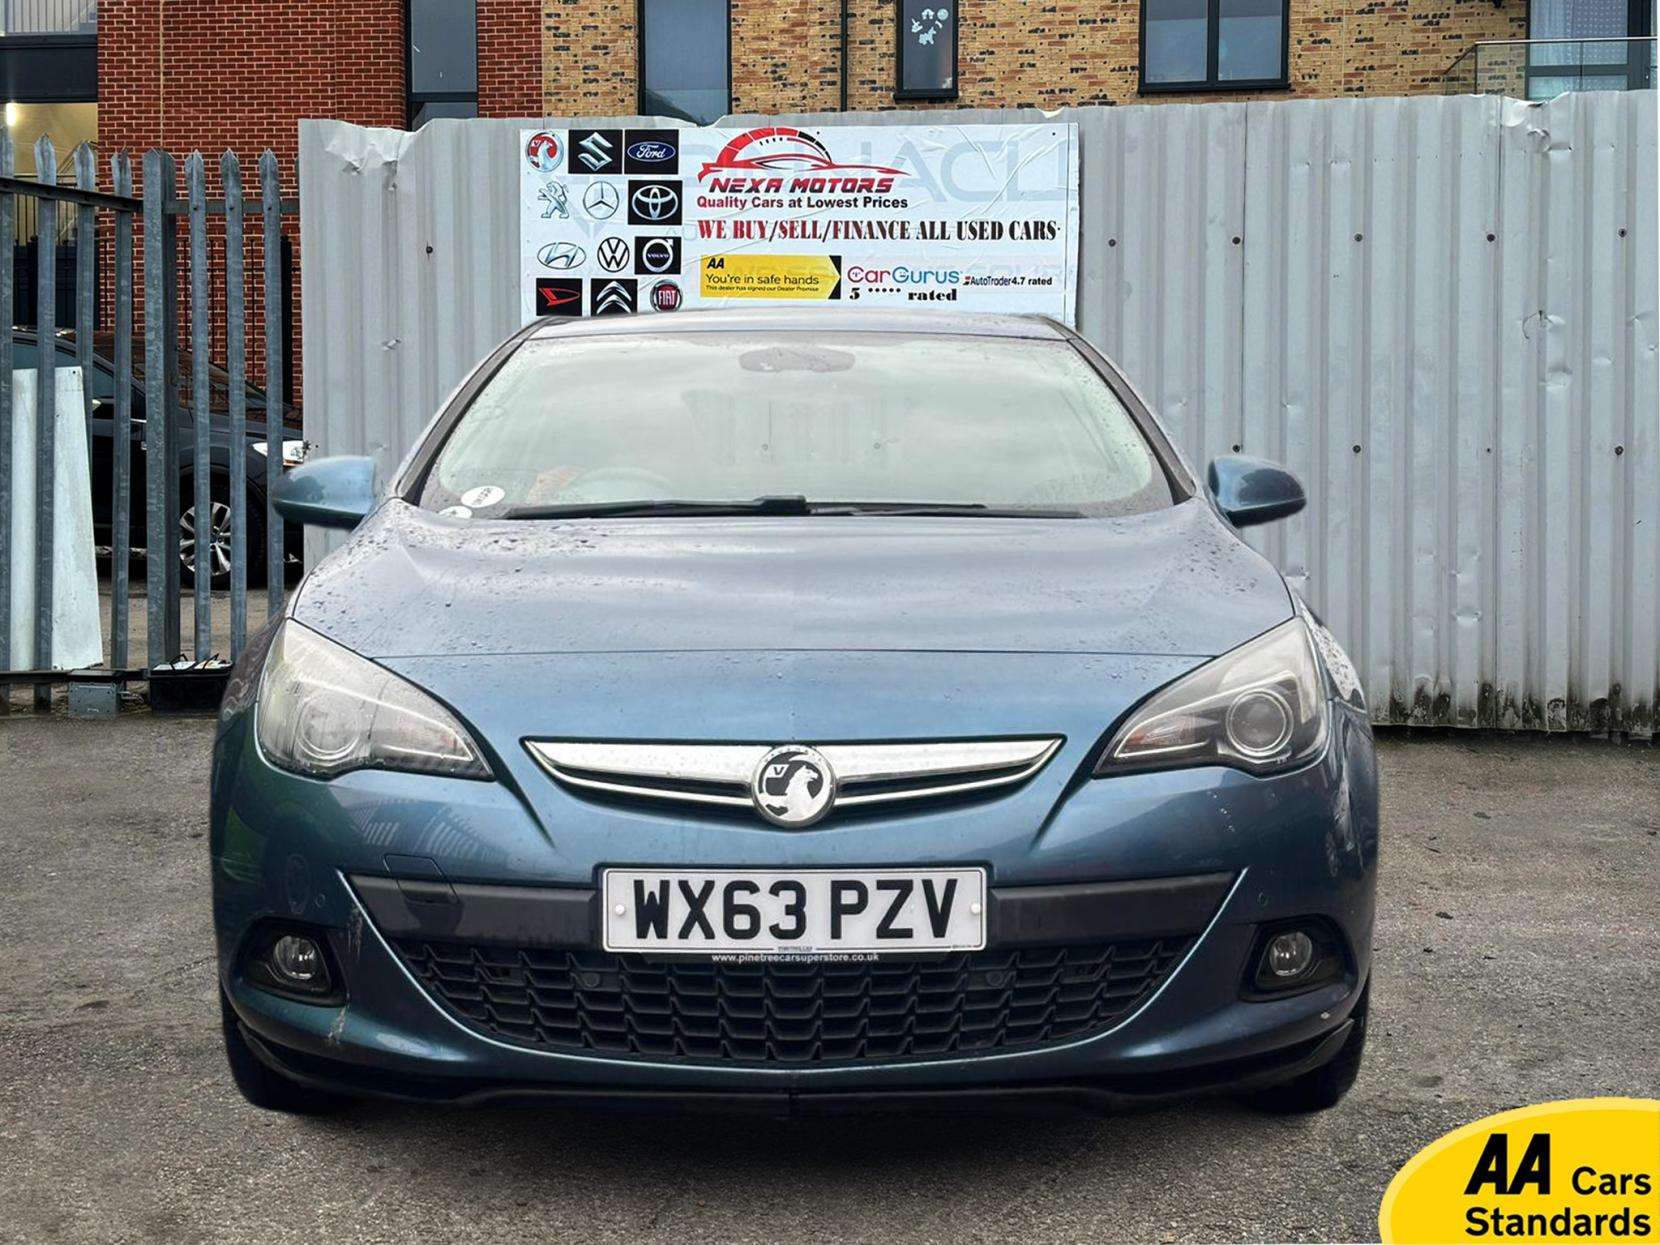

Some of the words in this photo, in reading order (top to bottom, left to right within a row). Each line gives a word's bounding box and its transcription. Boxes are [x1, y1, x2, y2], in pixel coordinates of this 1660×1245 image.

[636, 144, 665, 158] Ford
[709, 177, 784, 193] NEXA
[789, 177, 895, 193] MOTORS
[697, 196, 747, 210] Quality
[752, 196, 784, 208] Cars
[788, 197, 803, 208] at
[807, 196, 859, 208] Lowest
[863, 198, 909, 208] Prices
[697, 219, 727, 240] WE
[917, 220, 951, 240] ALL
[956, 220, 1004, 241] USED
[1008, 220, 1058, 241] CARS
[706, 257, 725, 269] AA
[705, 273, 741, 284] You're
[744, 273, 755, 284] in
[757, 273, 781, 285] safe
[783, 274, 820, 285] hands
[847, 266, 961, 284] CarGurus
[1027, 276, 1053, 285] rated
[658, 289, 676, 306] FIAT
[849, 287, 861, 300] 5
[907, 288, 958, 301] rated
[633, 879, 807, 940] WX63
[829, 878, 959, 939] PZV
[711, 952, 879, 964] www.pinetreecarsuperstore.co.uk
